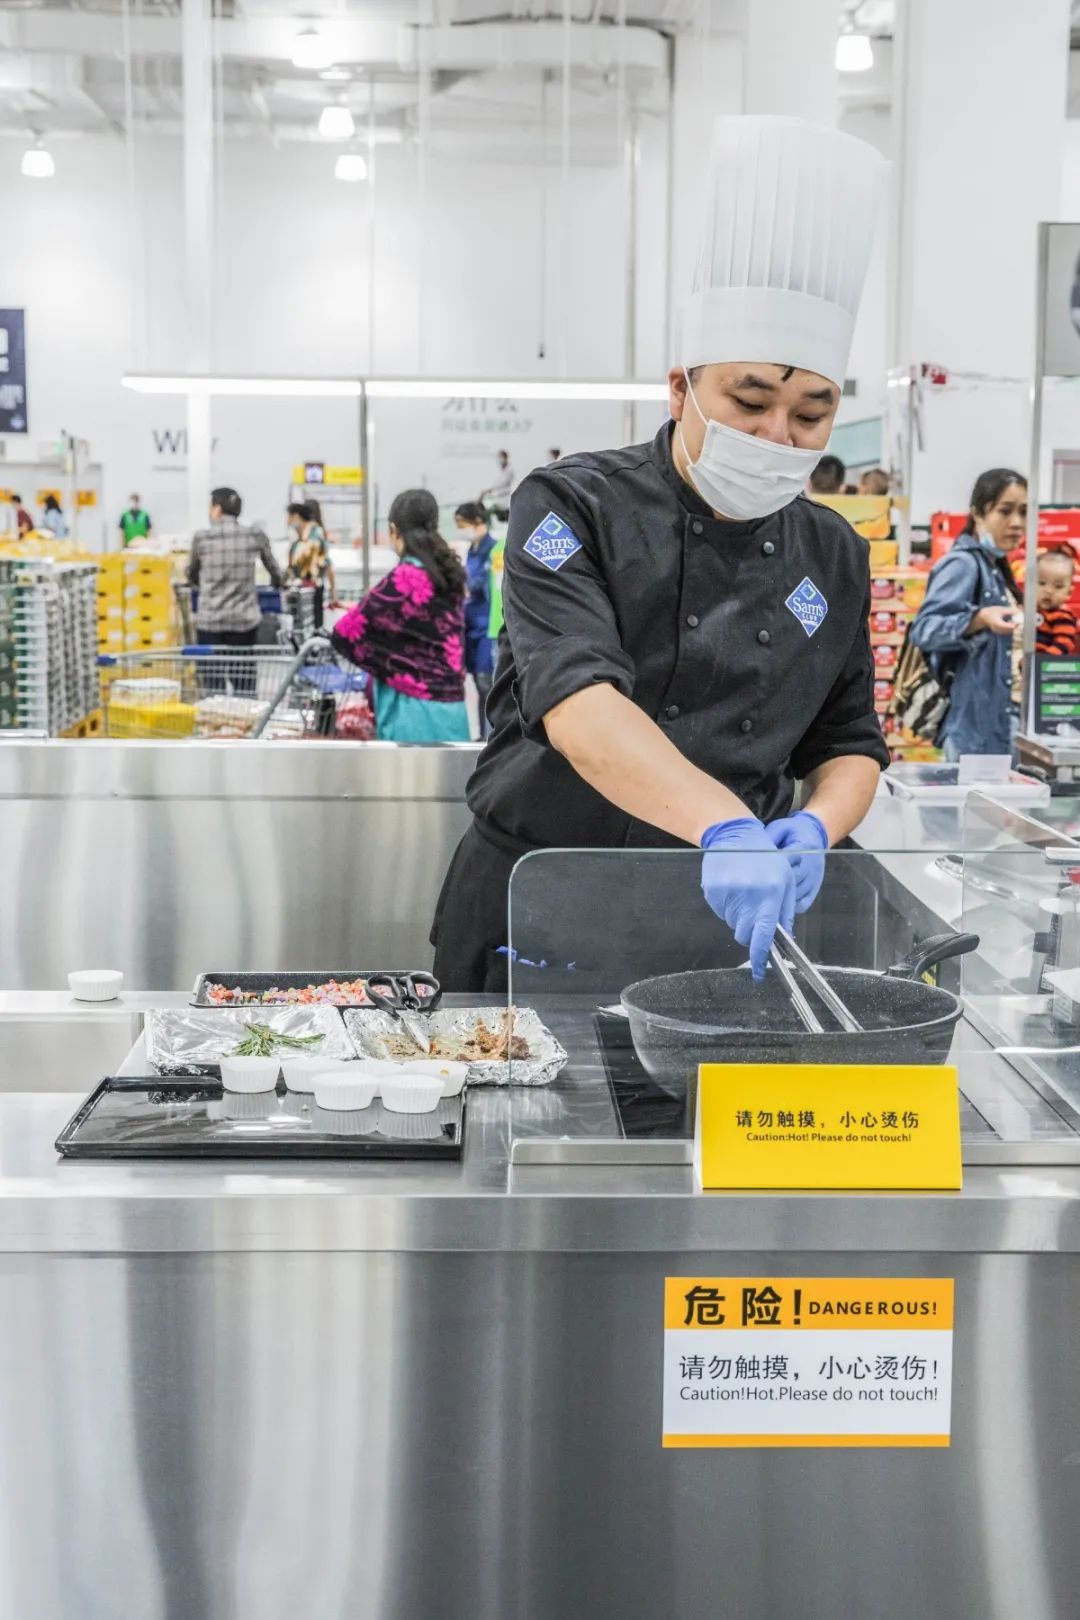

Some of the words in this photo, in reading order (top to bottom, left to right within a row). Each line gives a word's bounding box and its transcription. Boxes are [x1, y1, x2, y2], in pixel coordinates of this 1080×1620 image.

[532, 536, 575, 552] Sam's
[793, 597, 824, 618] Sam's
[811, 1133, 843, 1141] Please
[845, 1133, 858, 1142] do
[861, 1134, 878, 1142] not
[880, 1133, 912, 1142] touch!
[808, 1301, 938, 1315] DANGEROUS!
[832, 1386, 853, 1401] do
[858, 1388, 884, 1401] not
[890, 1386, 938, 1401] touch!
